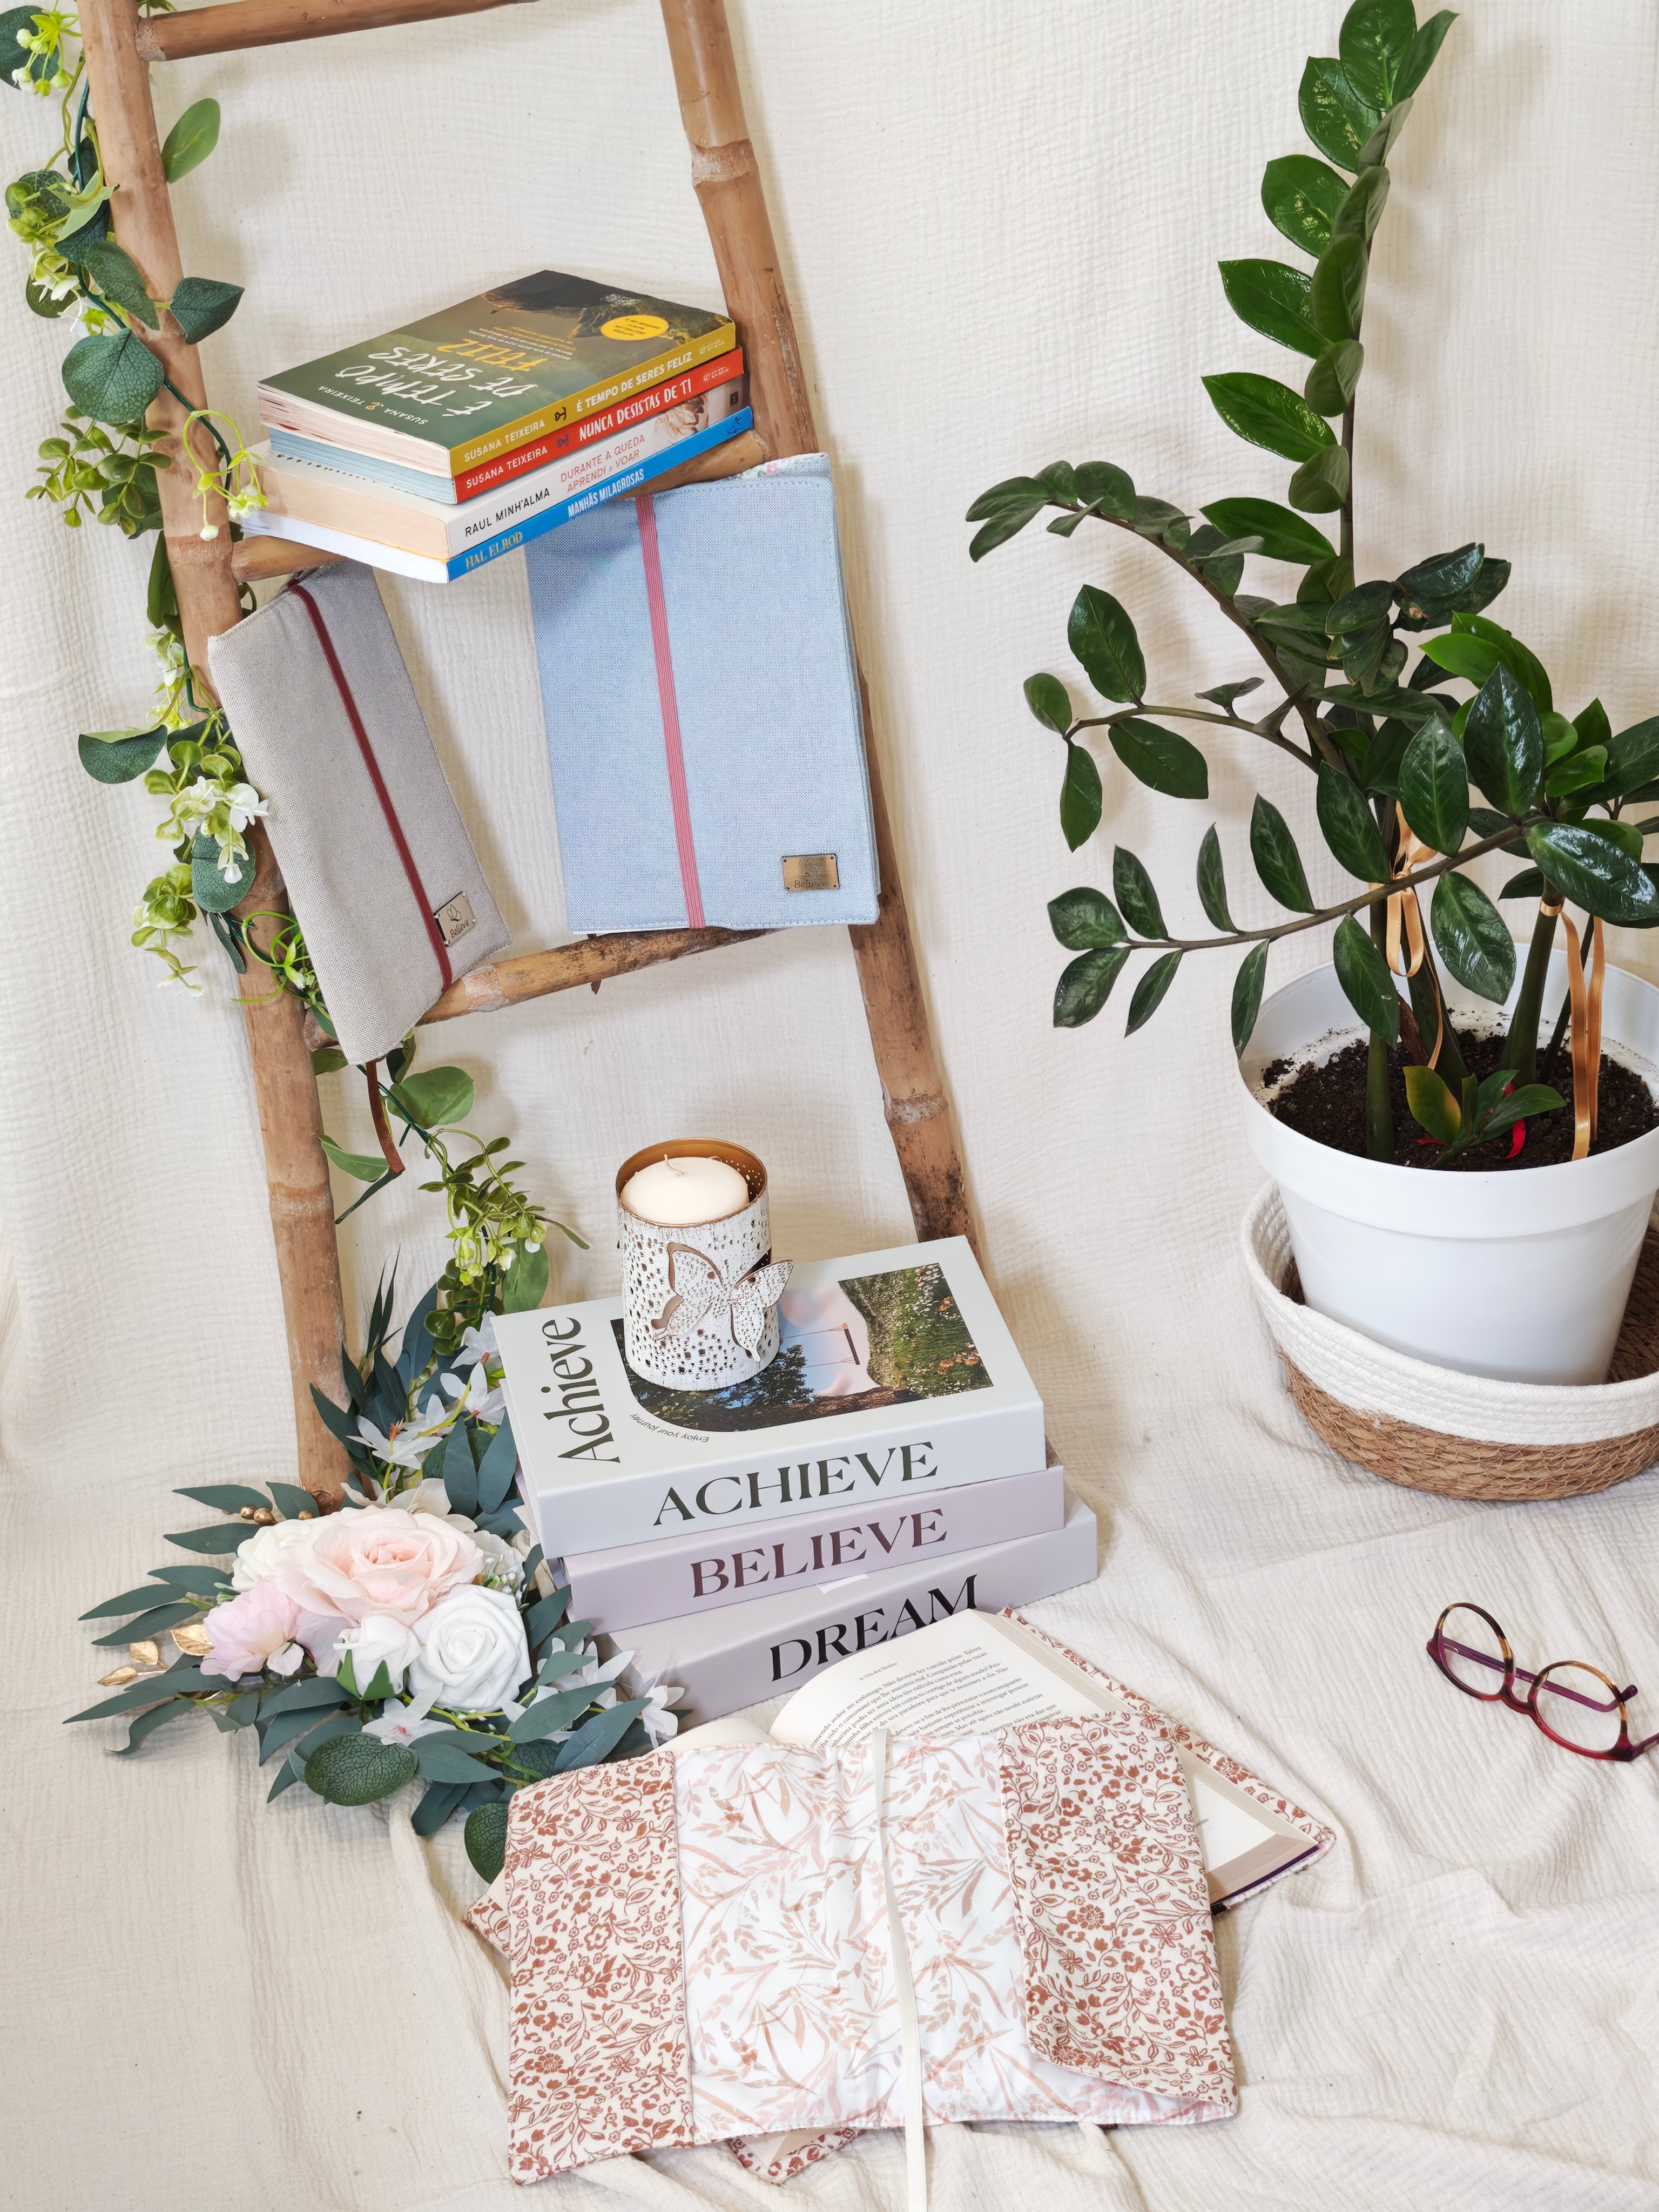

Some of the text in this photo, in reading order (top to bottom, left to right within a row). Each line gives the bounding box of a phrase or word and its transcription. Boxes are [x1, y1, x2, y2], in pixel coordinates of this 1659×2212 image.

[368, 347, 538, 397] DE SERES
[437, 339, 548, 372] FELIZ
[319, 386, 428, 425] SUSANA TEIXEIRA
[335, 366, 493, 417] É TEMPO
[464, 352, 692, 462] SUSANA TEIXEIRA É TEMPO DE SERES FELIZ
[466, 379, 691, 488] SUSANA TEIXEIRA NUNCA DESISTAS DE TI
[561, 434, 645, 483] DURANTE A QUEDA
[568, 466, 606, 493] APRENDI
[616, 450, 639, 468] VOAR
[465, 488, 550, 537] RAUL MINH'ALMA
[568, 468, 644, 517] MANHÃS MILAGROSAS
[466, 551, 487, 570] HAL
[450, 920, 470, 939] Believe
[541, 1317, 620, 1464] Achieve
[629, 1413, 709, 1442] Enjoy your journey
[653, 1441, 939, 1526] ACHIEVE
[690, 1509, 948, 1599] BELIEVE
[770, 1574, 979, 1683] DREAM
[827, 1728, 839, 1740] sido
[843, 1701, 870, 1724] consommé
[891, 1681, 915, 1692] assentou
[926, 1664, 958, 1677] Compaixão
[958, 1658, 972, 1667] pelas
[972, 1652, 989, 1660] vacas.
[831, 1709, 846, 1724] ardor
[855, 1687, 883, 1703] estômago.
[896, 1672, 917, 1682] deveria
[926, 1661, 947, 1671] comido
[947, 1654, 964, 1663] peixe.
[962, 1646, 982, 1655] Talvez
[852, 1715, 868, 1728] podia
[876, 1701, 889, 1709] uma
[889, 1694, 903, 1702] ideia
[913, 1680, 934, 1691] ridícula
[934, 1675, 950, 1683] como
[860, 1719, 873, 1731] filha
[873, 1708, 892, 1721] entrou
[901, 1692, 925, 1705] contacto
[925, 1684, 946, 1694] contigo
[953, 1675, 971, 1683] algum
[970, 1667, 989, 1676] modo?
[899, 1700, 925, 1716] paradeiro
[926, 1695, 939, 1703] para
[956, 1677, 982, 1690] reunisses
[995, 1667, 1009, 1675] Não
[919, 1717, 943, 1731] bastante
[943, 1704, 975, 1719] experiência
[980, 1691, 1008, 1705] interrogar
[1008, 1683, 1029, 1694] pessoas
[951, 1695, 979, 1709] perscrutar
[983, 1688, 997, 1696] rosto
[997, 1677, 1022, 1690] enquanto
[977, 1714, 993, 1722] agora
[1004, 1702, 1022, 1711] recebi
[1022, 1694, 1043, 1704] notícias
[1046, 1703, 1057, 1711] que
[934, 1721, 954, 1732] sempre
[961, 1709, 986, 1721] percebia.
